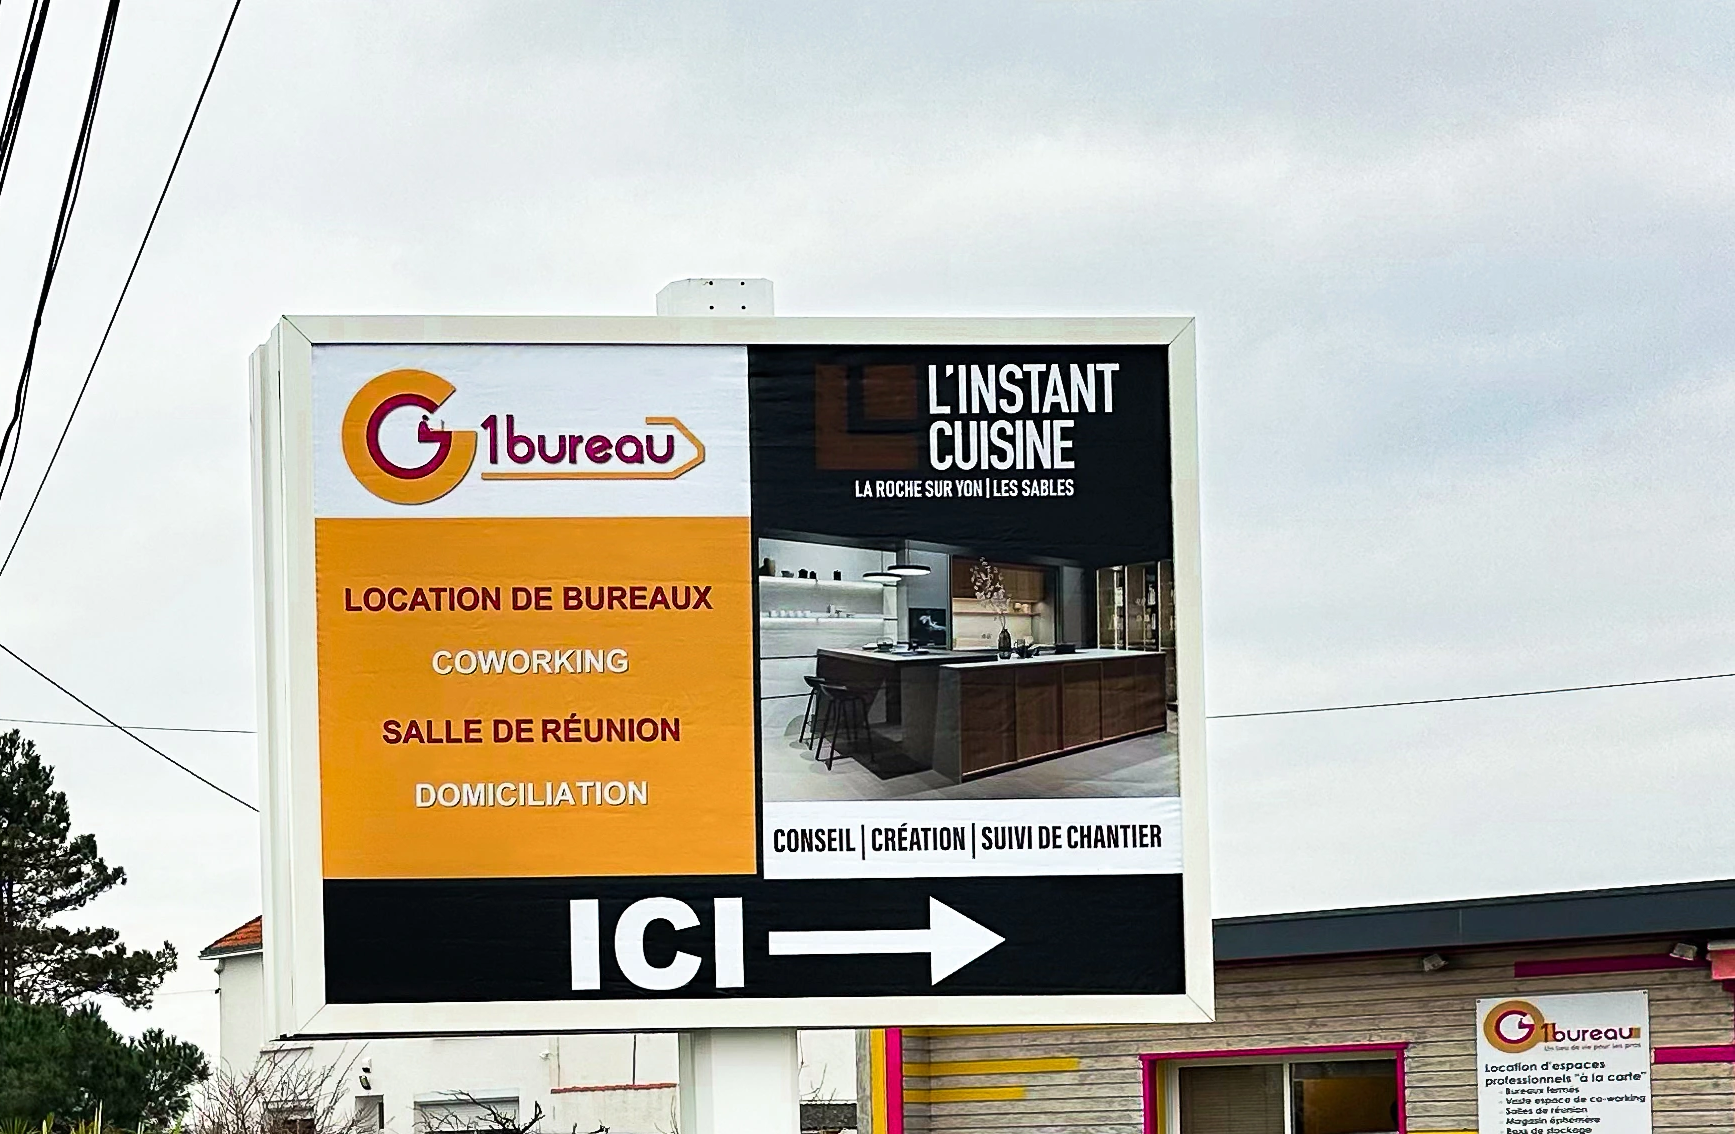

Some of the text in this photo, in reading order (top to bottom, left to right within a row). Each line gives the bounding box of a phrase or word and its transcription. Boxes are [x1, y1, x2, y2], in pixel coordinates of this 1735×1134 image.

[928, 363, 1120, 414] L'INSTANT
[929, 420, 1075, 471] CUISINE
[855, 478, 1074, 498] LA ROCHE SUR YON LES SABLES
[344, 586, 714, 612] LOCATION DE BUREAUX
[431, 648, 629, 675] COWORKING
[382, 713, 680, 744] SALLE DE RÉUNION
[415, 781, 649, 809] DOMICILIATION
[773, 823, 1162, 853] CONSEIL CRÉATION SUIVI DE CHANTIER
[569, 896, 745, 991] ICI
[1484, 1060, 1606, 1073] Location d'espaces
[1485, 1074, 1572, 1088] professionnels
[1591, 1072, 1604, 1082] la
[1573, 1095, 1587, 1103] de
